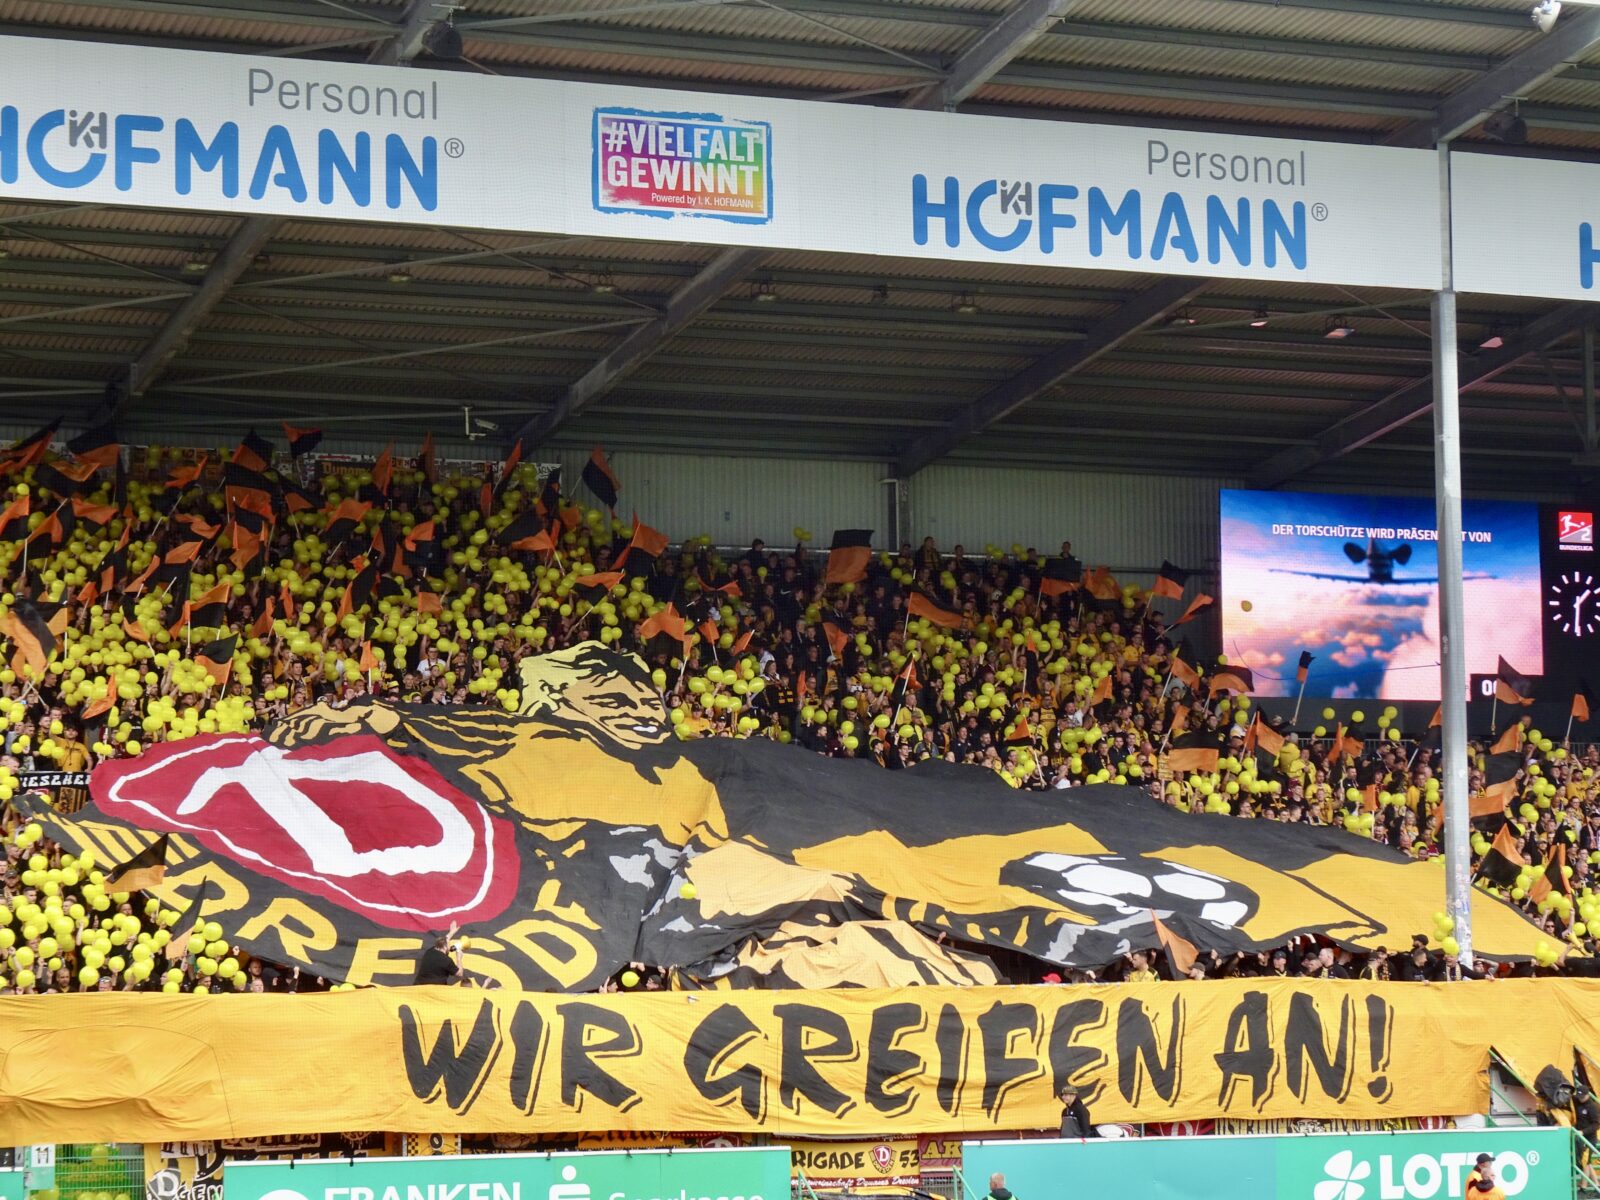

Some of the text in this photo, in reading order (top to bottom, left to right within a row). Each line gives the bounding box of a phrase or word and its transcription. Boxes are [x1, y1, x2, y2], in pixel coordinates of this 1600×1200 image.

[249, 68, 437, 120] Personal
[605, 121, 760, 162] #VIELFALT
[1148, 140, 1306, 187] Personal
[607, 155, 759, 195] GEWINNT
[652, 192, 685, 203] Powered
[686, 195, 696, 206] by
[714, 197, 754, 208] HOFMANN
[912, 173, 1307, 270] HOFMANN
[1272, 524, 1294, 535] DER
[1295, 524, 1364, 537] TORSCHÜTZE
[1366, 527, 1395, 538] WIRD
[1468, 531, 1491, 542] VON
[398, 991, 1396, 1125] WIR GREIFEN AN!
